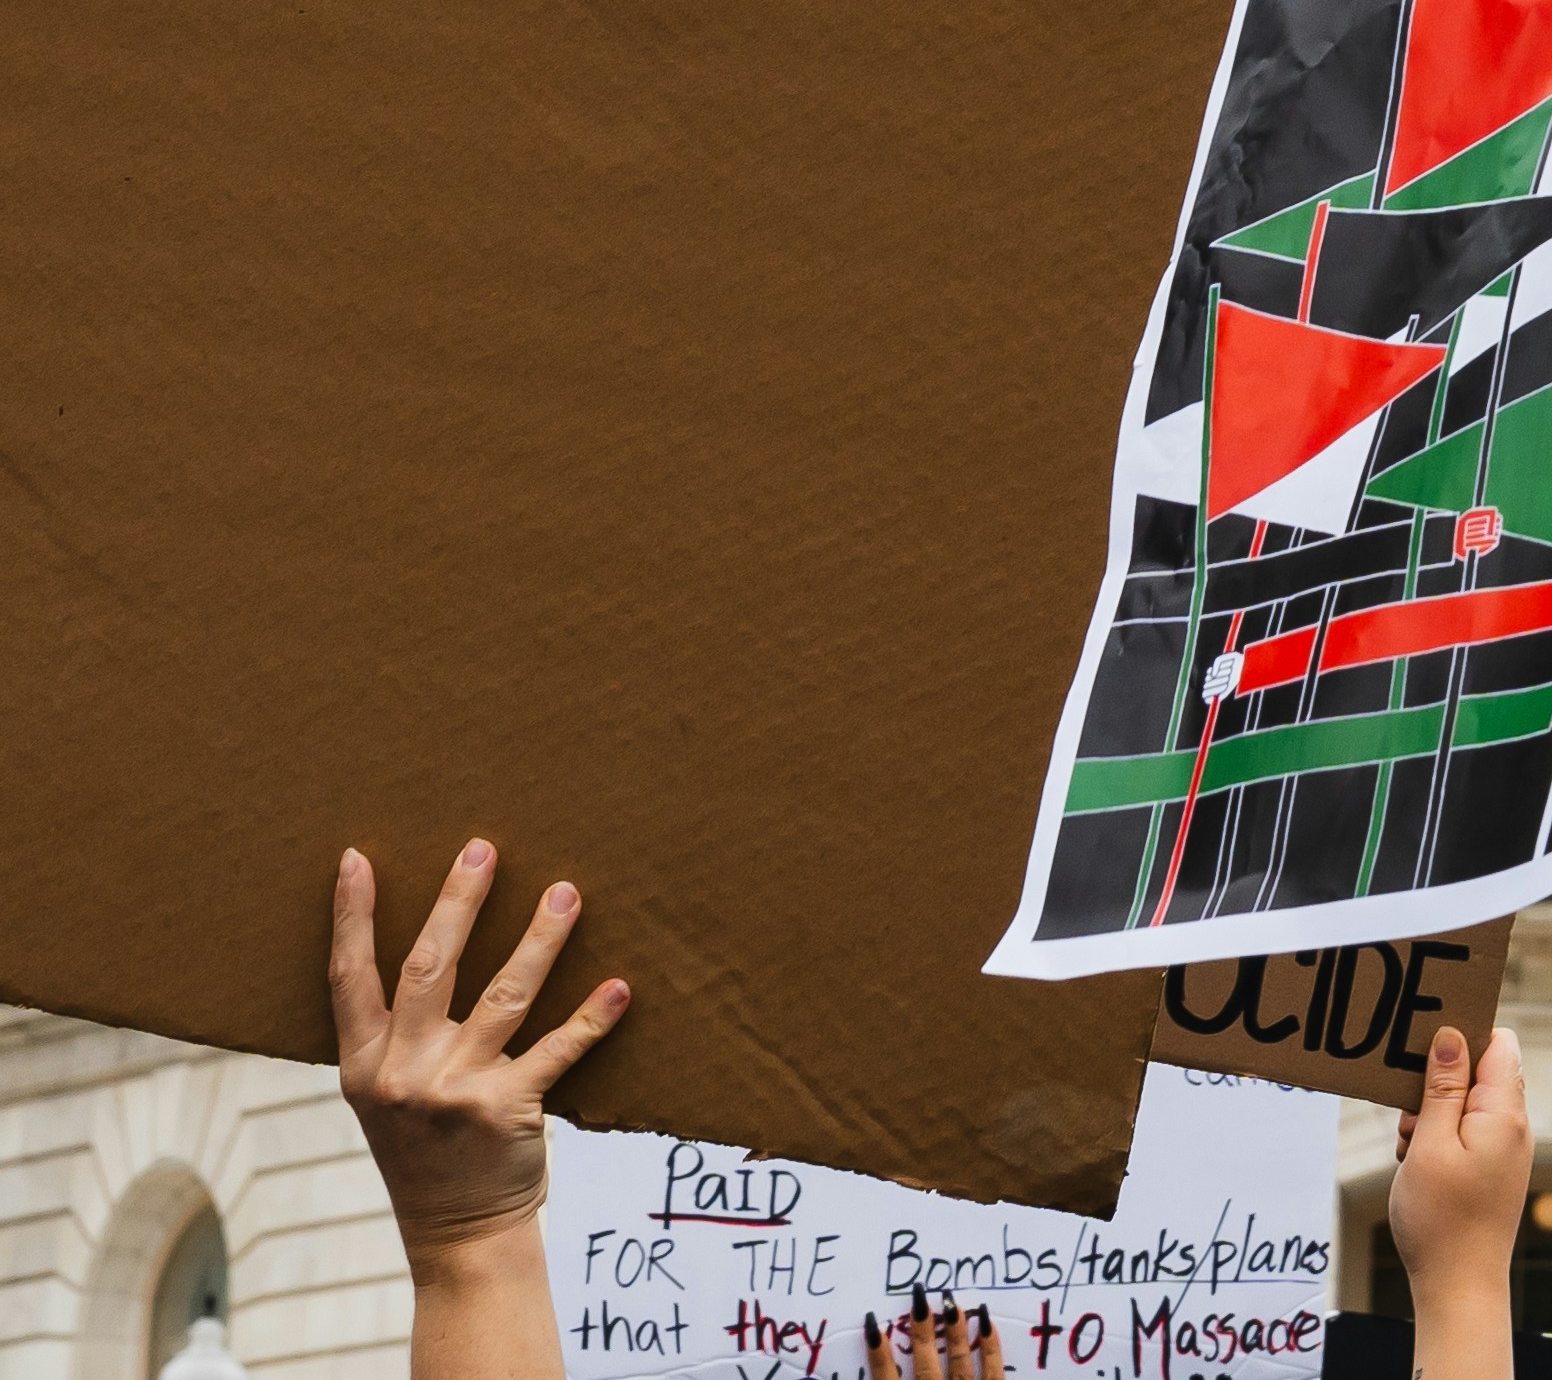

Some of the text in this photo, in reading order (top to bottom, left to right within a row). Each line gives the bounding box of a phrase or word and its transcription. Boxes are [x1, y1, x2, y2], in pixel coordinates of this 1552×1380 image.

[586, 1229, 686, 1291] FOR
[732, 1234, 842, 1297] THE
[570, 1299, 689, 1355] that
[723, 1297, 828, 1376] they
[1030, 1296, 1106, 1370] to
